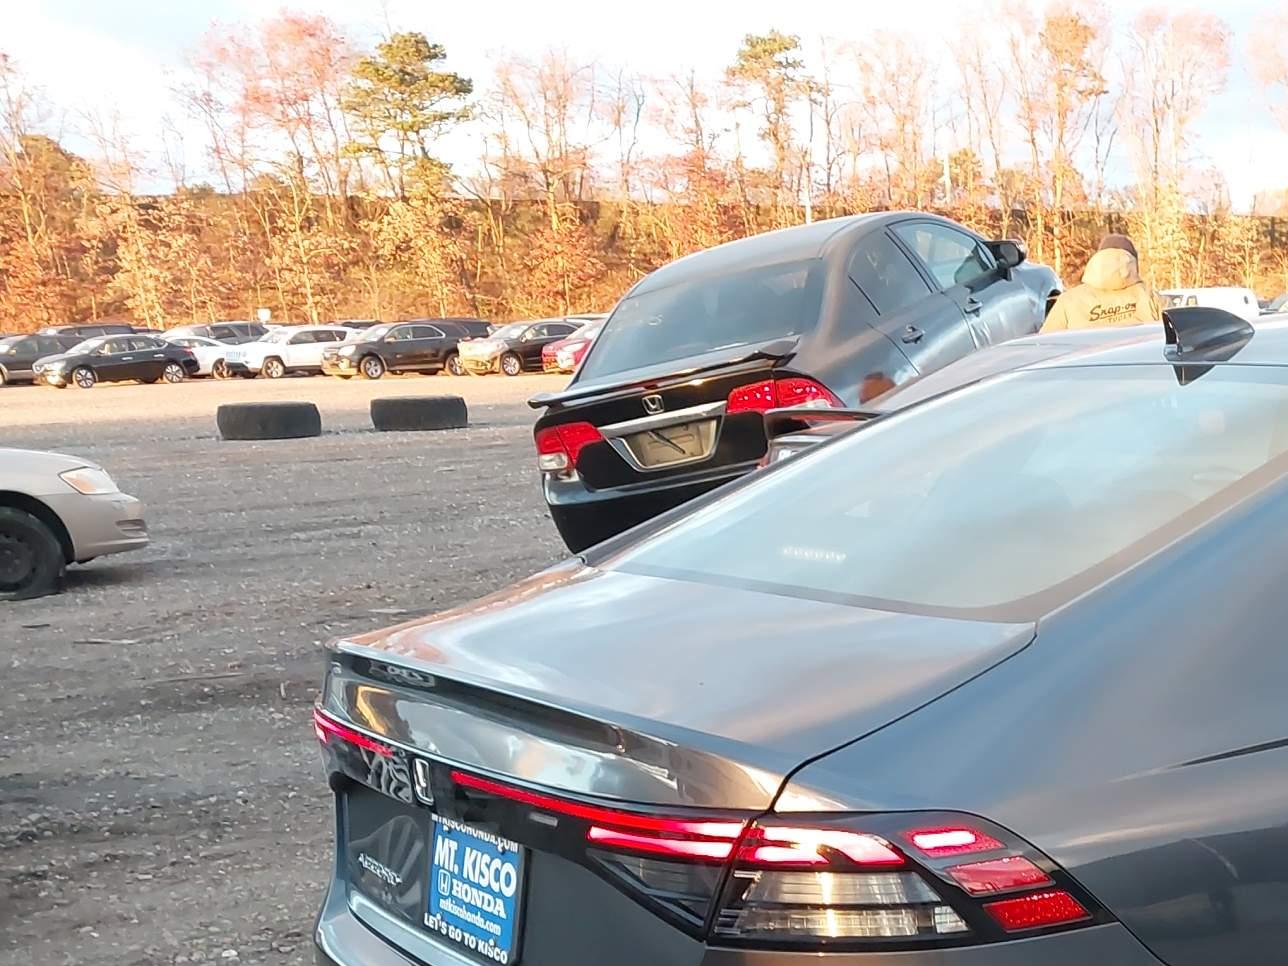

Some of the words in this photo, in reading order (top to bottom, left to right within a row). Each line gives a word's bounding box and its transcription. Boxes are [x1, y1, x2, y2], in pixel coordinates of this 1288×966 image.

[1088, 302, 1137, 322] Snap-on
[434, 834, 459, 875] MT.
[463, 846, 517, 898] KISCO
[451, 878, 507, 920] HONDA
[448, 924, 462, 943] GO
[463, 931, 477, 950] TO
[477, 939, 508, 965] KISCO
